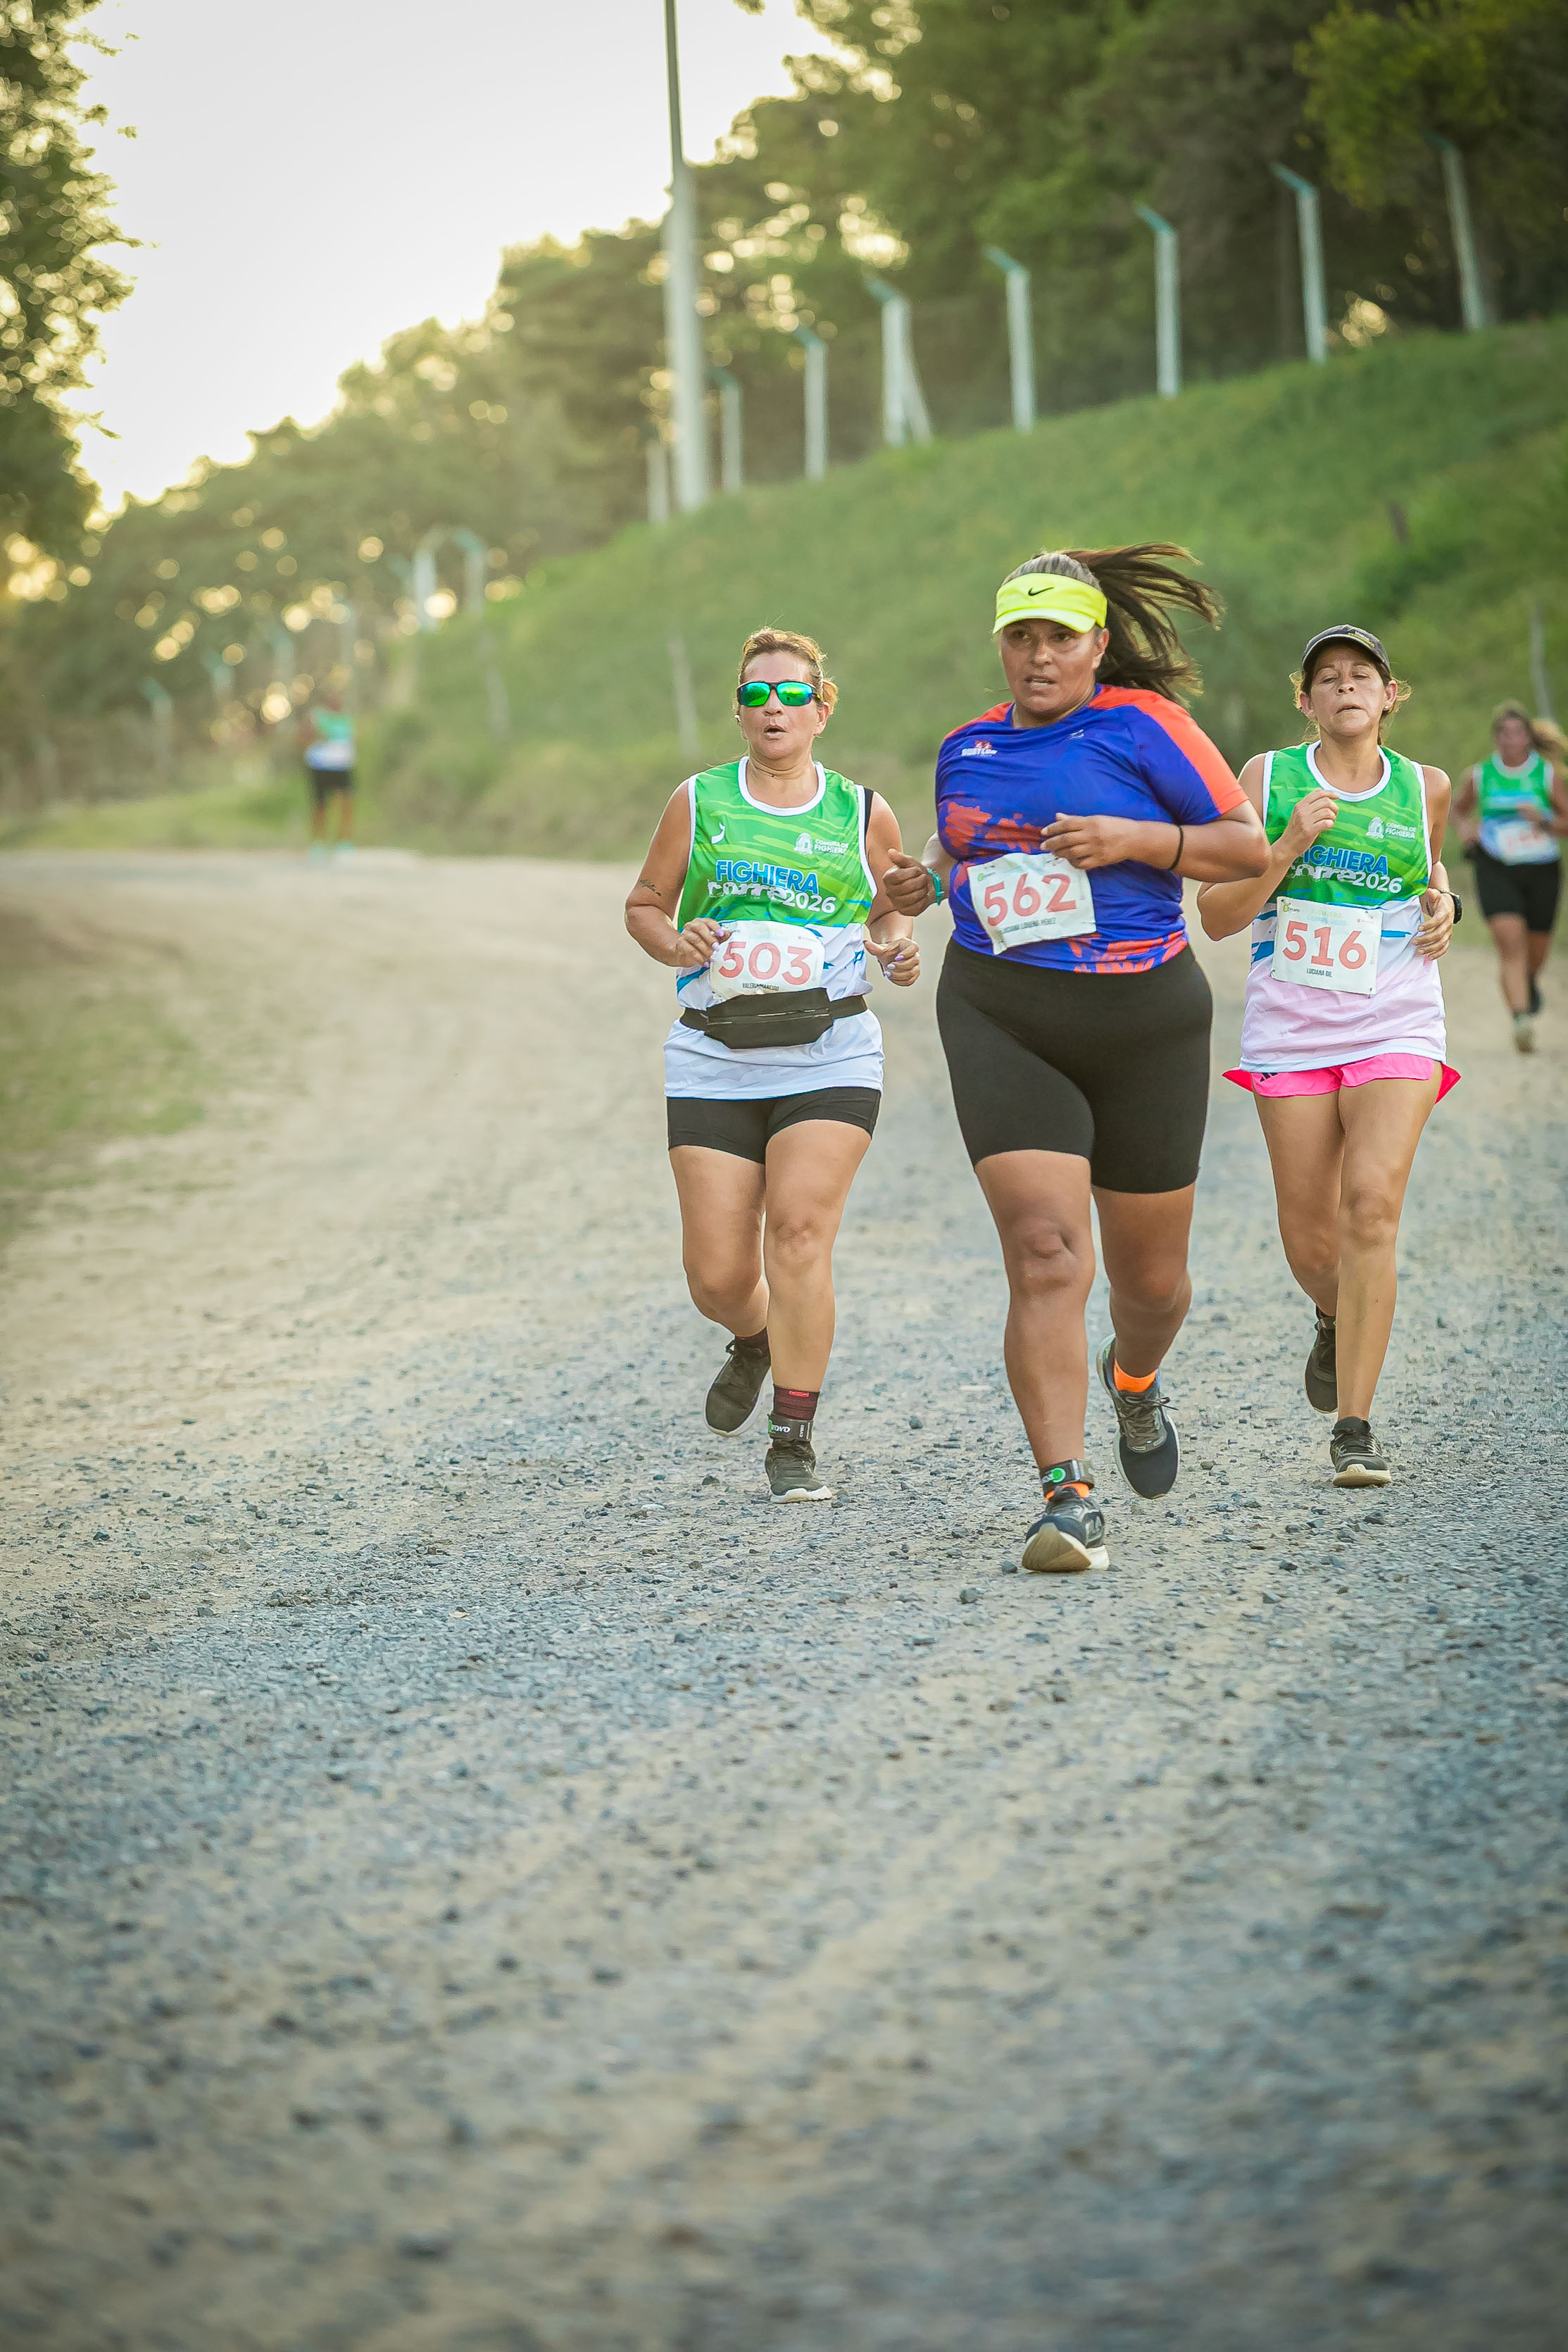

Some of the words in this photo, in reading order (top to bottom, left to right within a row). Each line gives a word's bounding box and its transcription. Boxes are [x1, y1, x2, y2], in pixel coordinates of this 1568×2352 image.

[1385, 827, 1415, 839] FIGHIERA
[715, 860, 819, 894] FIGHIERA
[1295, 845, 1388, 877] IGHIERA
[984, 872, 1077, 926] 562
[718, 942, 813, 985] 503
[1283, 920, 1367, 970] 516
